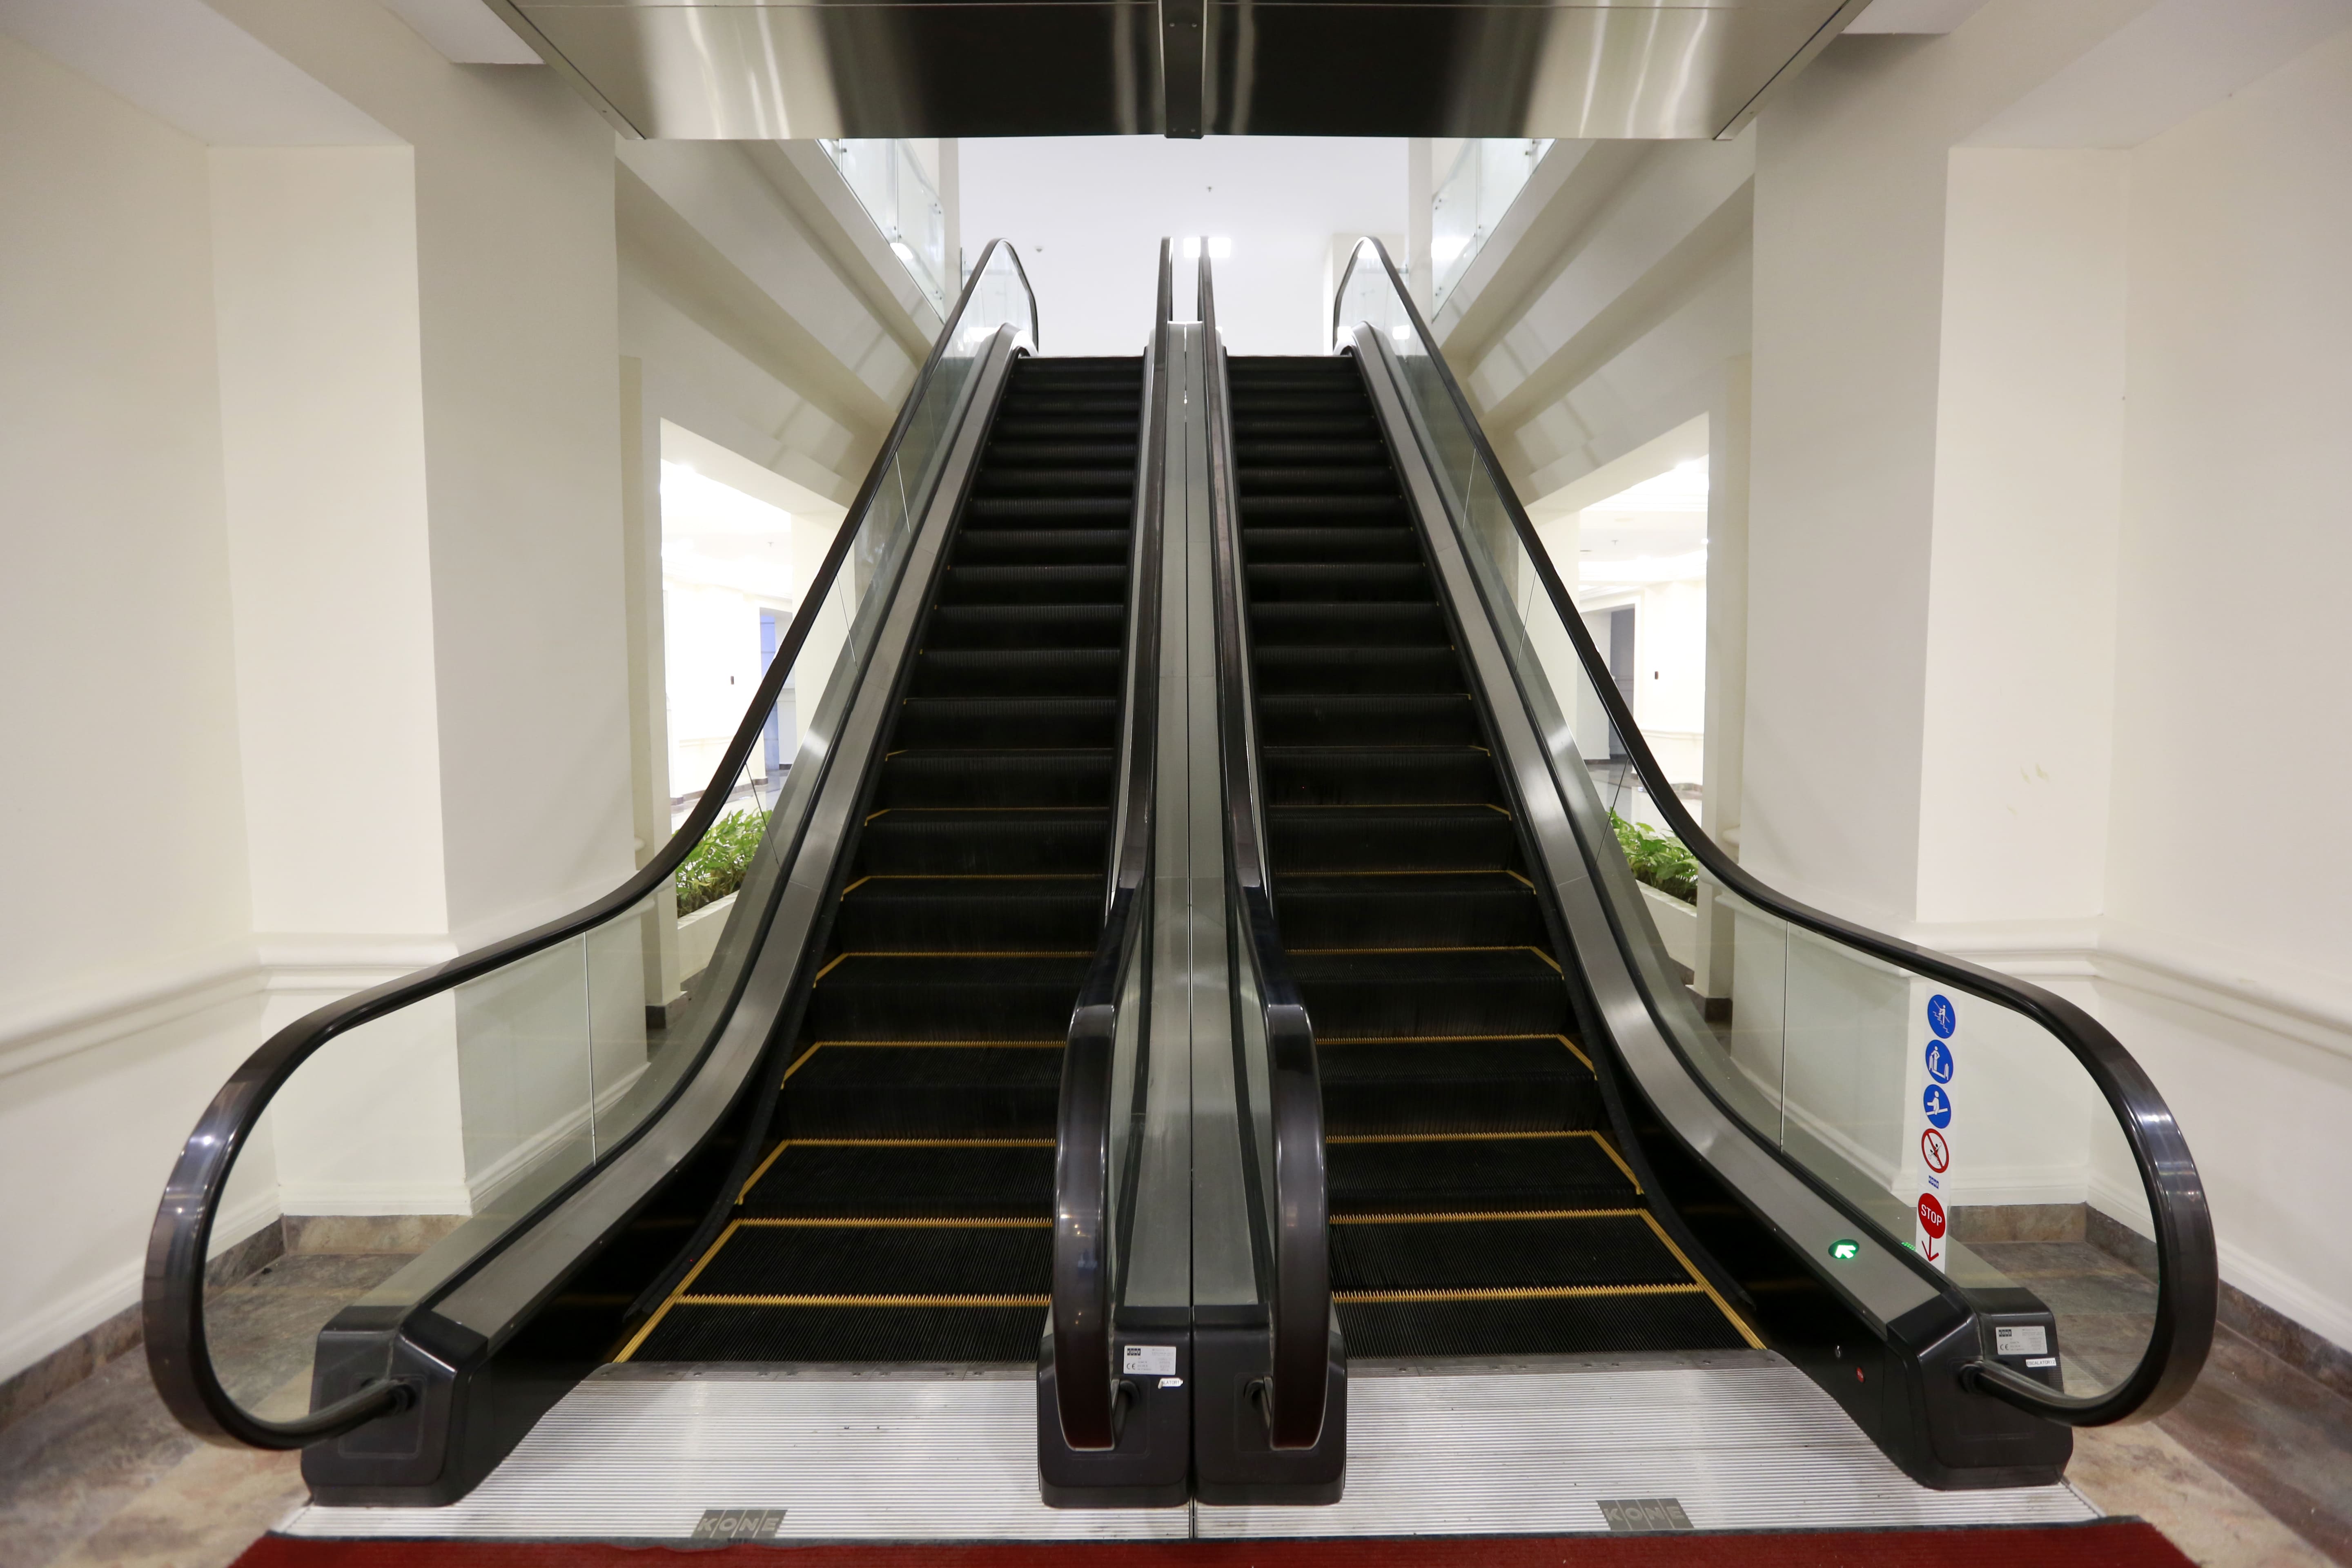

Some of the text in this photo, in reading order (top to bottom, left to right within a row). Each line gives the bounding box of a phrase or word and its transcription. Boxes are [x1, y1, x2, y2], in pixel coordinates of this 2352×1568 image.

[1921, 1204, 1942, 1226] STOP
[1603, 1506, 1685, 1521] KONE
[697, 1517, 779, 1531] KONE
